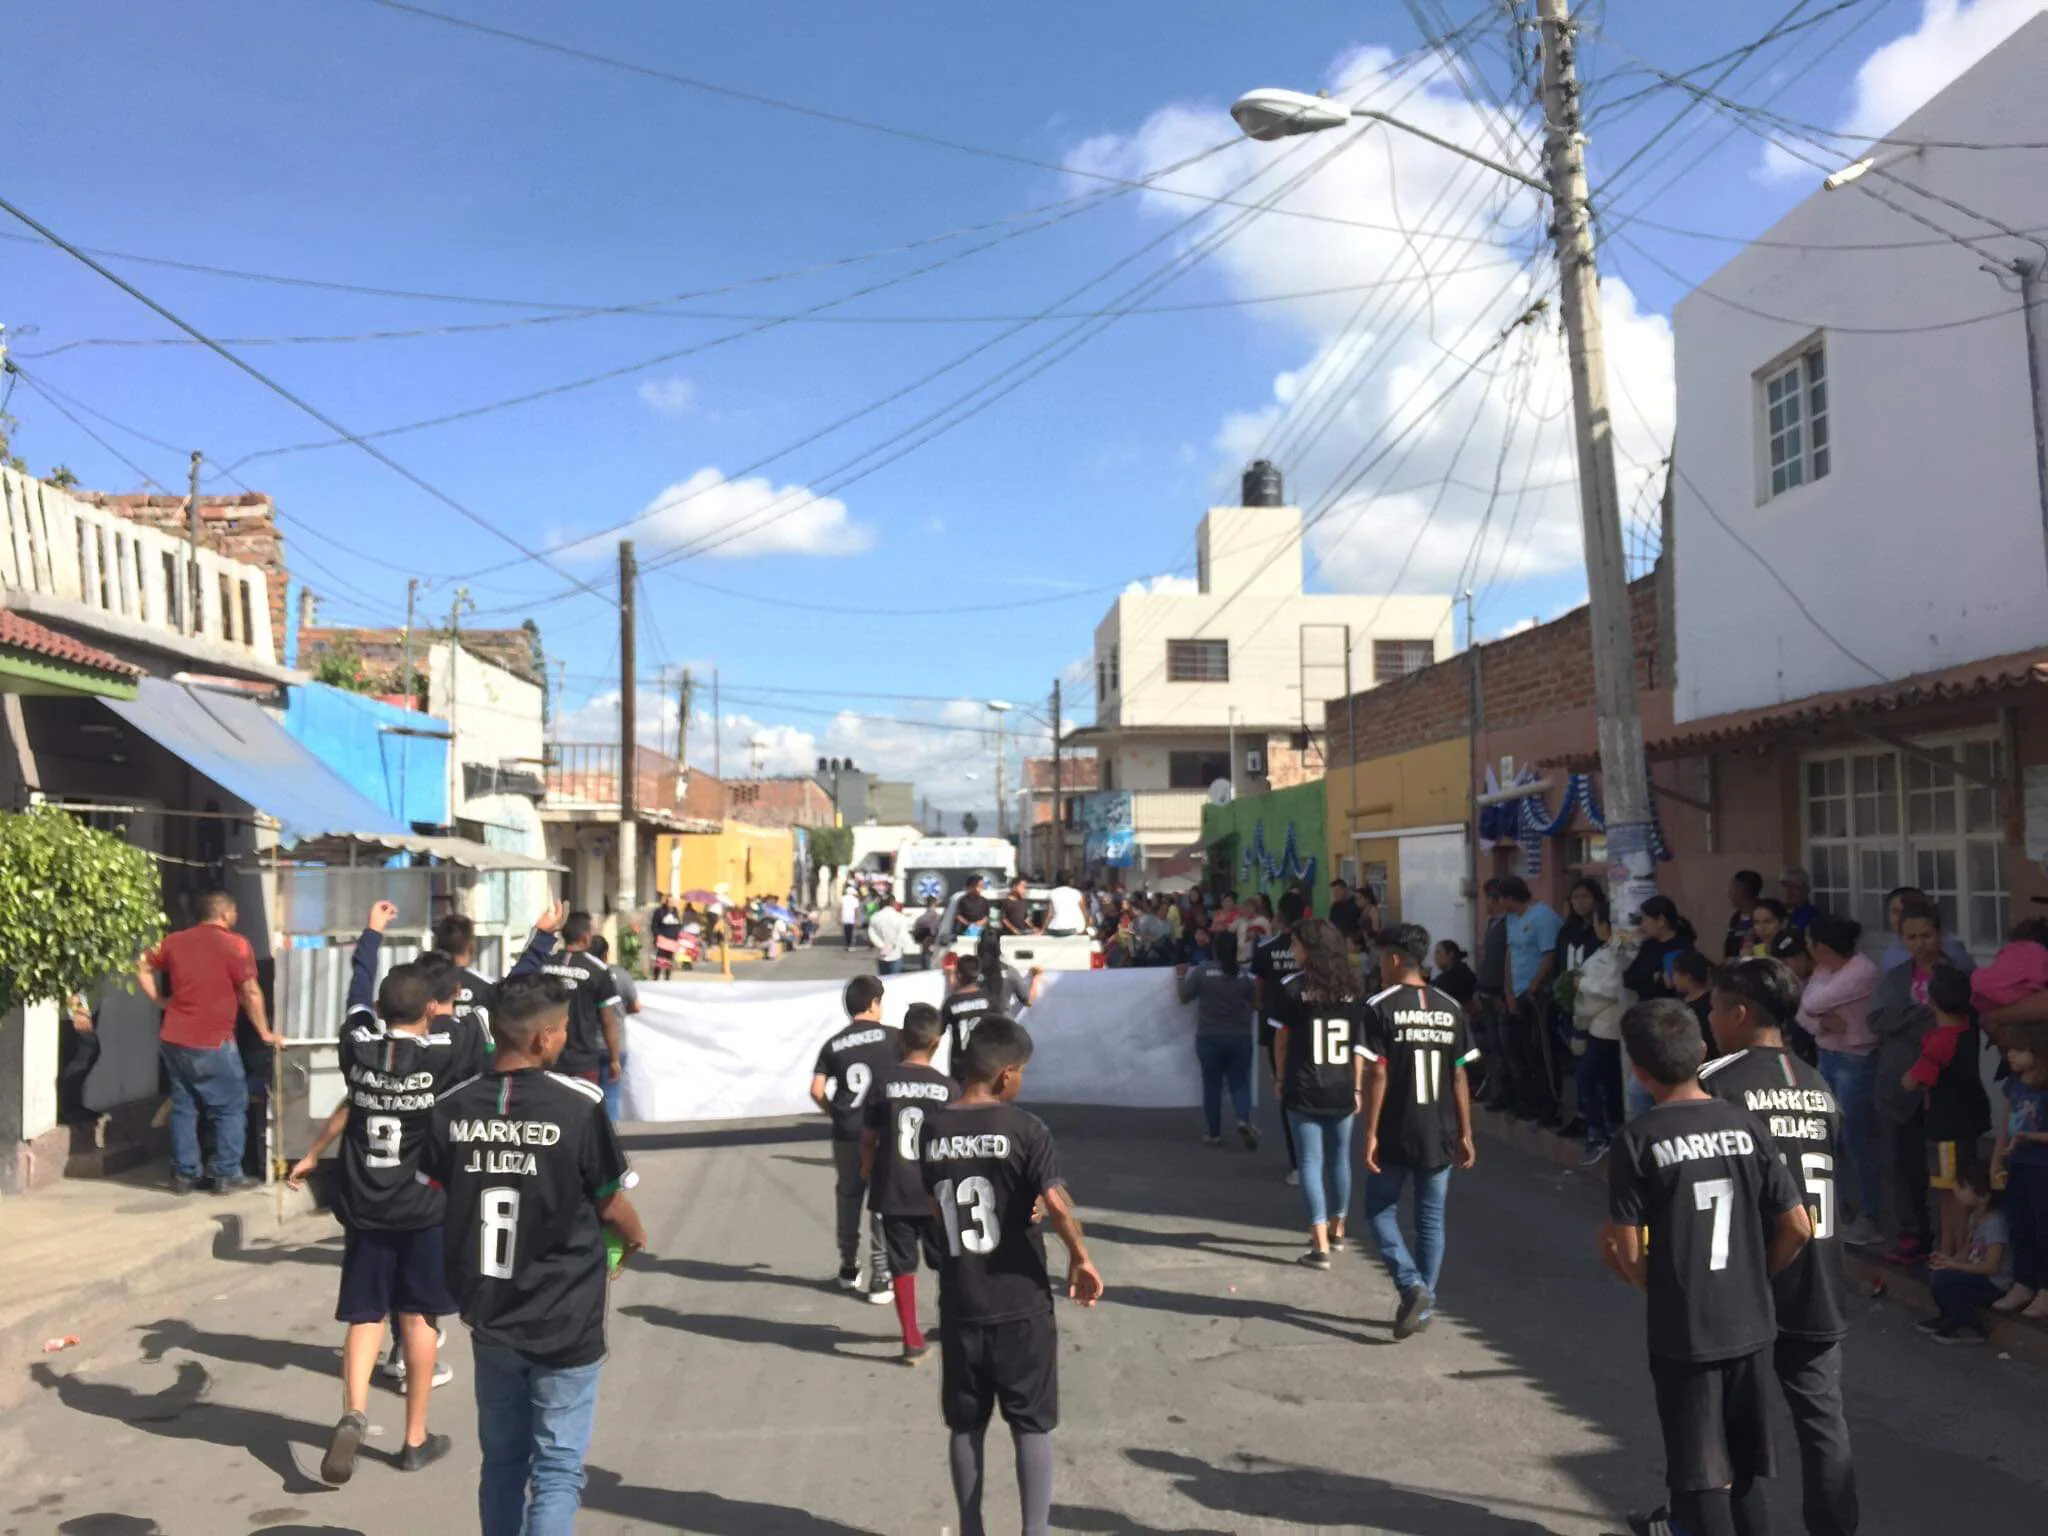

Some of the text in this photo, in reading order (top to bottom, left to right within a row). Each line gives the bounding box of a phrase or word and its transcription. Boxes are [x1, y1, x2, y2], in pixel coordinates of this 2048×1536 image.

[1393, 1010, 1455, 1027] MARKED
[832, 1028, 886, 1052] MARKED
[1312, 1018, 1350, 1065] 12
[846, 1062, 872, 1108] 9
[886, 1081, 949, 1102] MARKED
[1414, 1048, 1441, 1104] 11
[449, 1119, 561, 1146] MARKED
[925, 1134, 1011, 1161] MARKED
[1651, 1129, 1755, 1168] MARKED
[464, 1149, 482, 1173] J
[933, 1175, 1001, 1257] 13
[1778, 1151, 1835, 1240] 5
[480, 1186, 520, 1279] 8
[1692, 1178, 1735, 1271] 7
